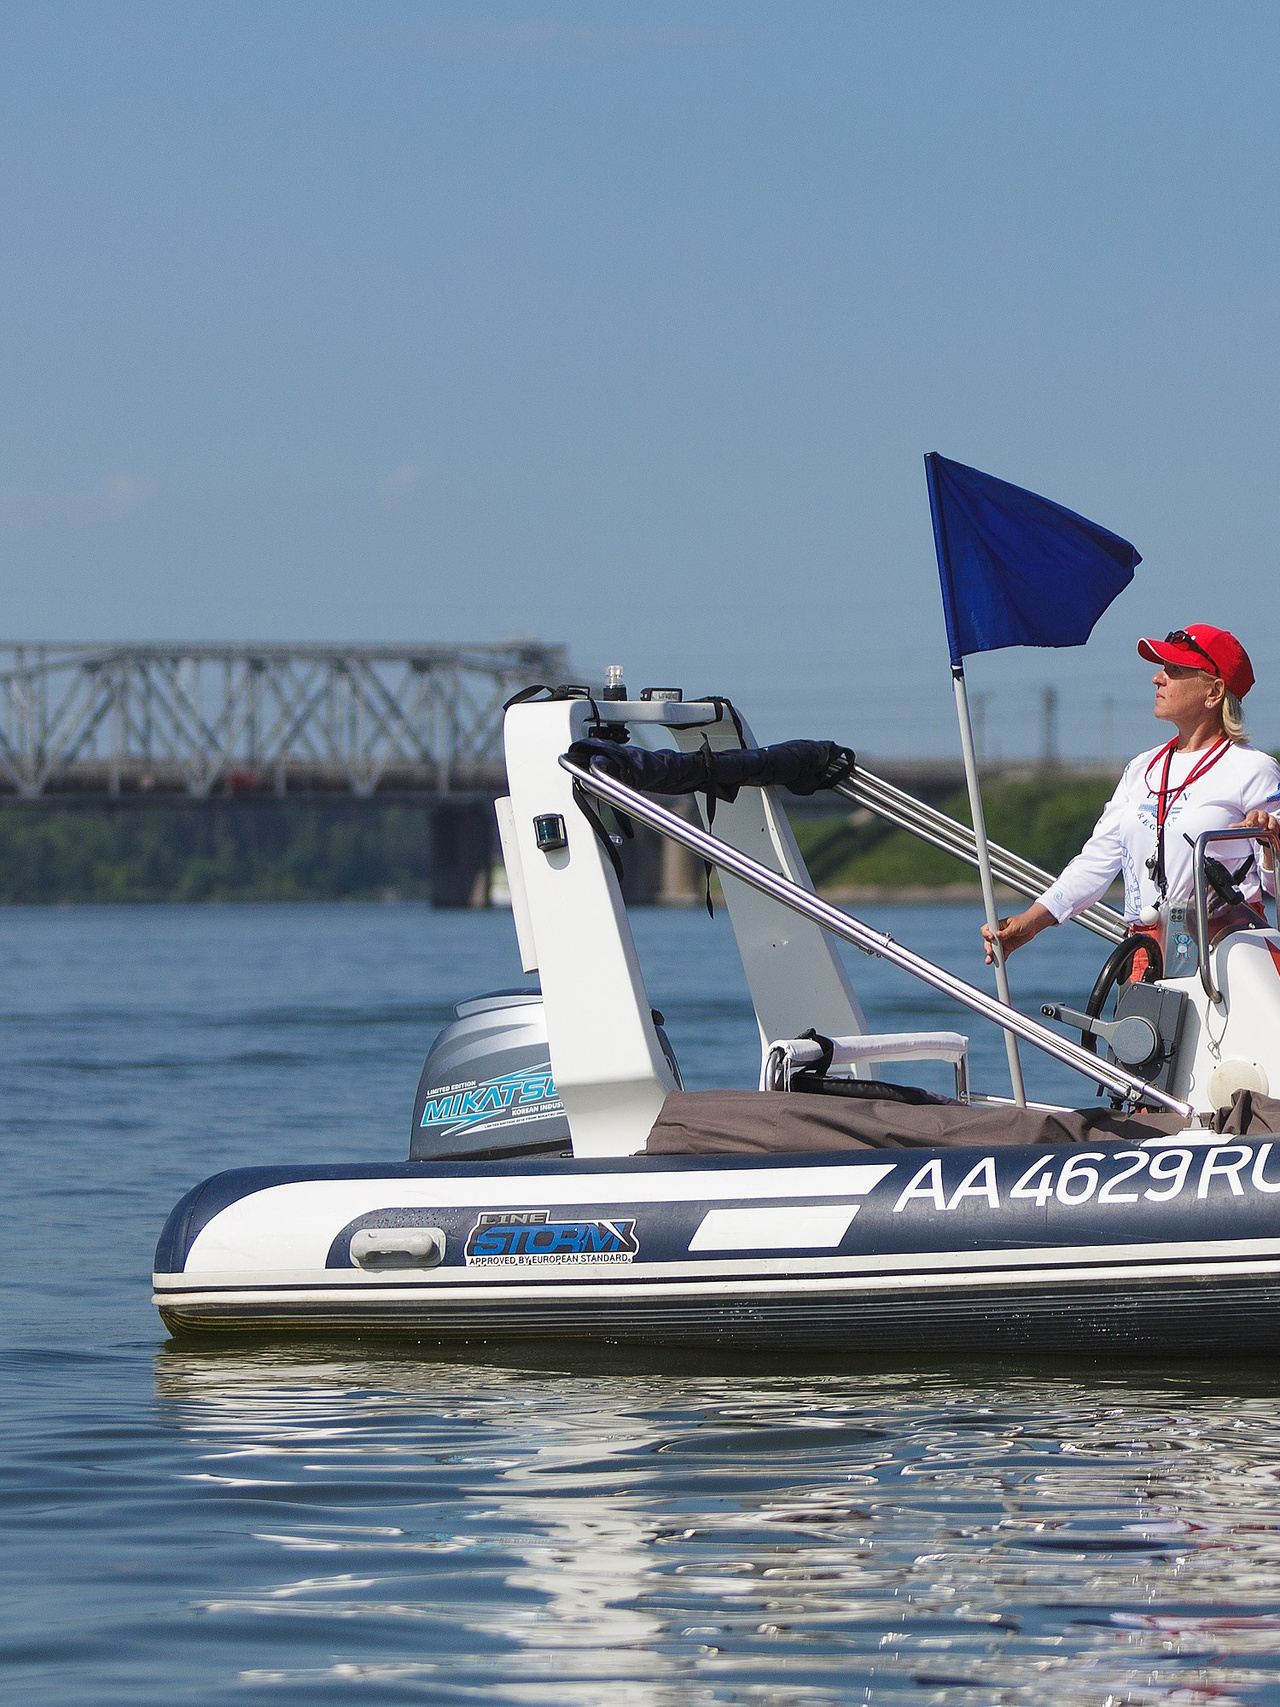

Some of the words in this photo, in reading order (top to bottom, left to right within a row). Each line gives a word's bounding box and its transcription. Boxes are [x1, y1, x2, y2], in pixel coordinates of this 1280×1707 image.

[427, 1086, 450, 1096] LIMITED
[451, 1080, 476, 1090] EDITION
[511, 1106, 539, 1117] KOREAN
[893, 1156, 1001, 1212] AA
[1008, 1150, 1193, 1206] 4629
[481, 1214, 545, 1225] LINE
[473, 1223, 626, 1255] STORM
[469, 1256, 516, 1266] APPROVED
[518, 1256, 532, 1264] BY
[532, 1255, 579, 1264] EUROPEAN
